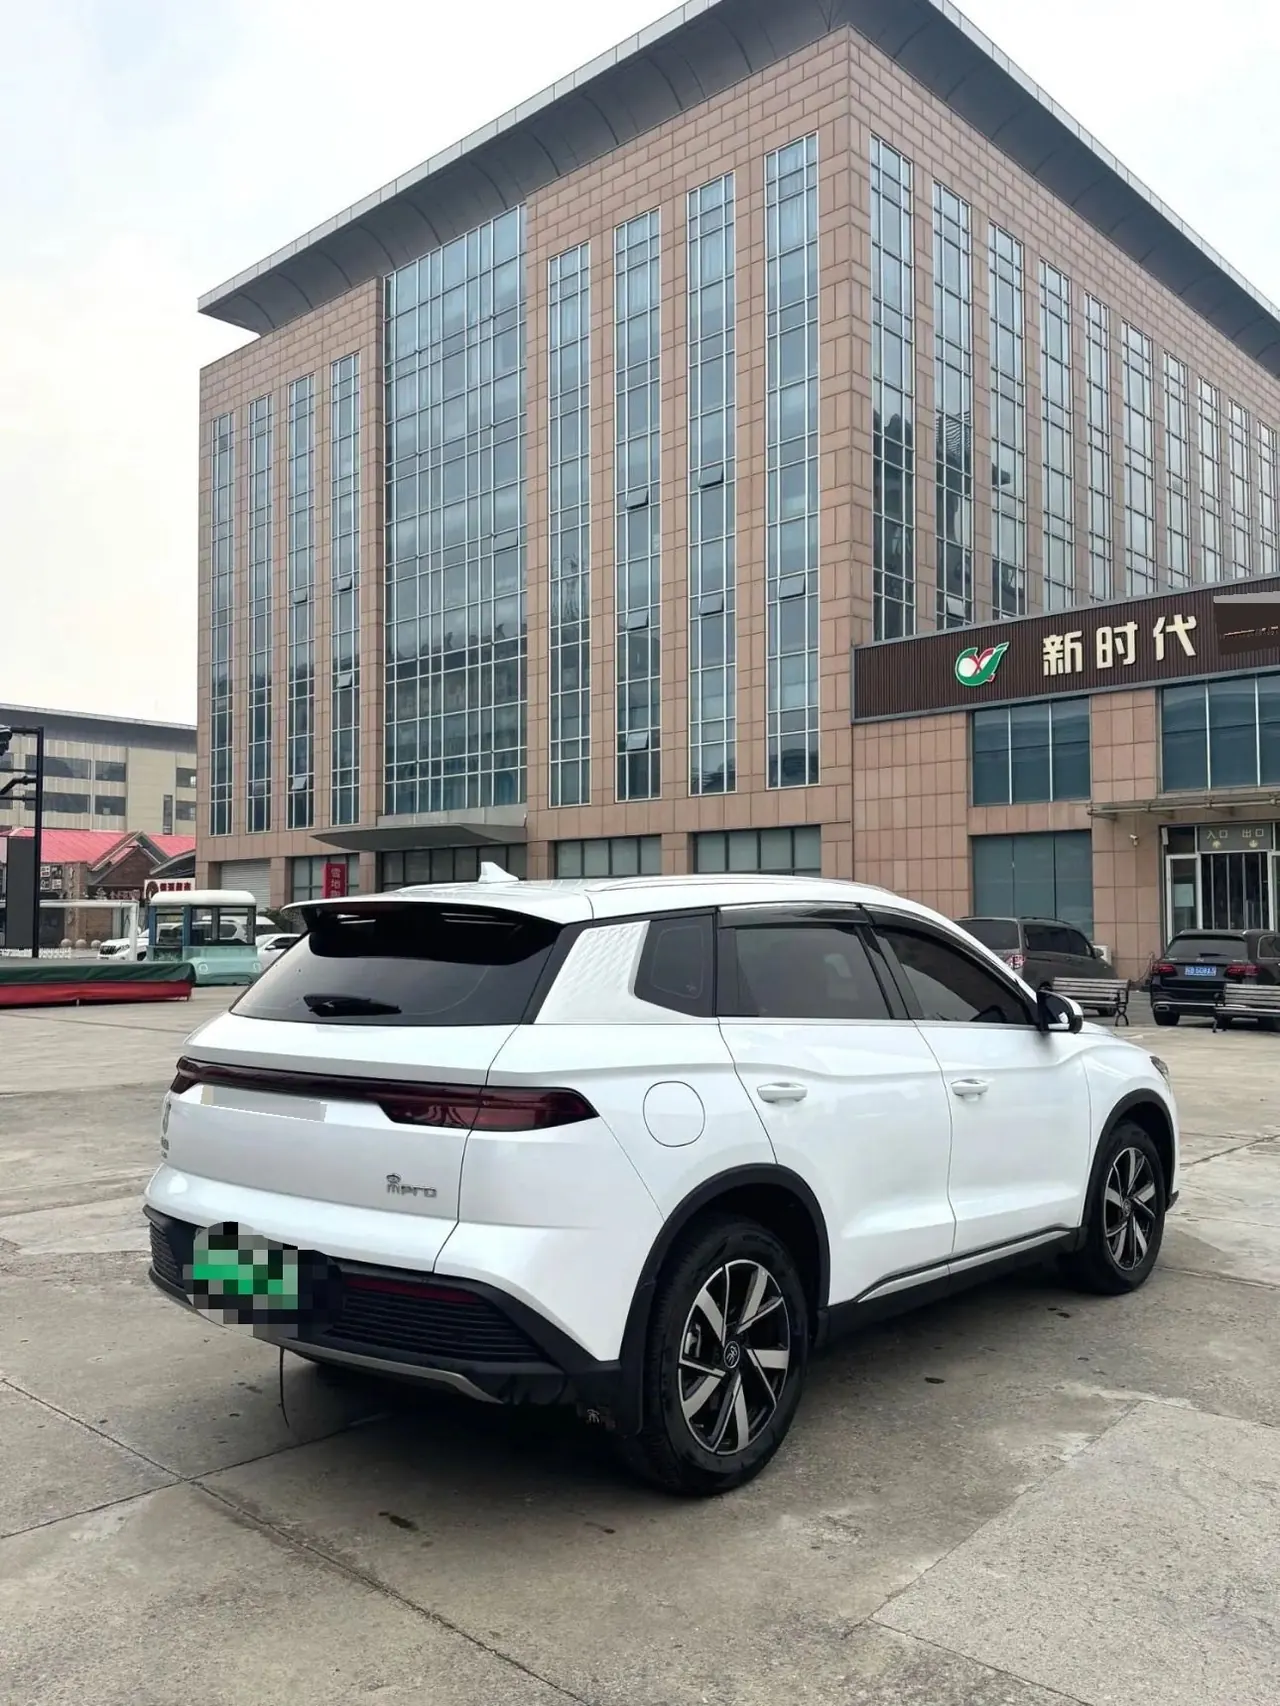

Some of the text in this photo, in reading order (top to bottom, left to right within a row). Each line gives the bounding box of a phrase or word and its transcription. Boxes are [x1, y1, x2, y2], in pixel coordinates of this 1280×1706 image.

[1042, 613, 1197, 676] 新时代
[1206, 828, 1264, 840] 入口 出口
